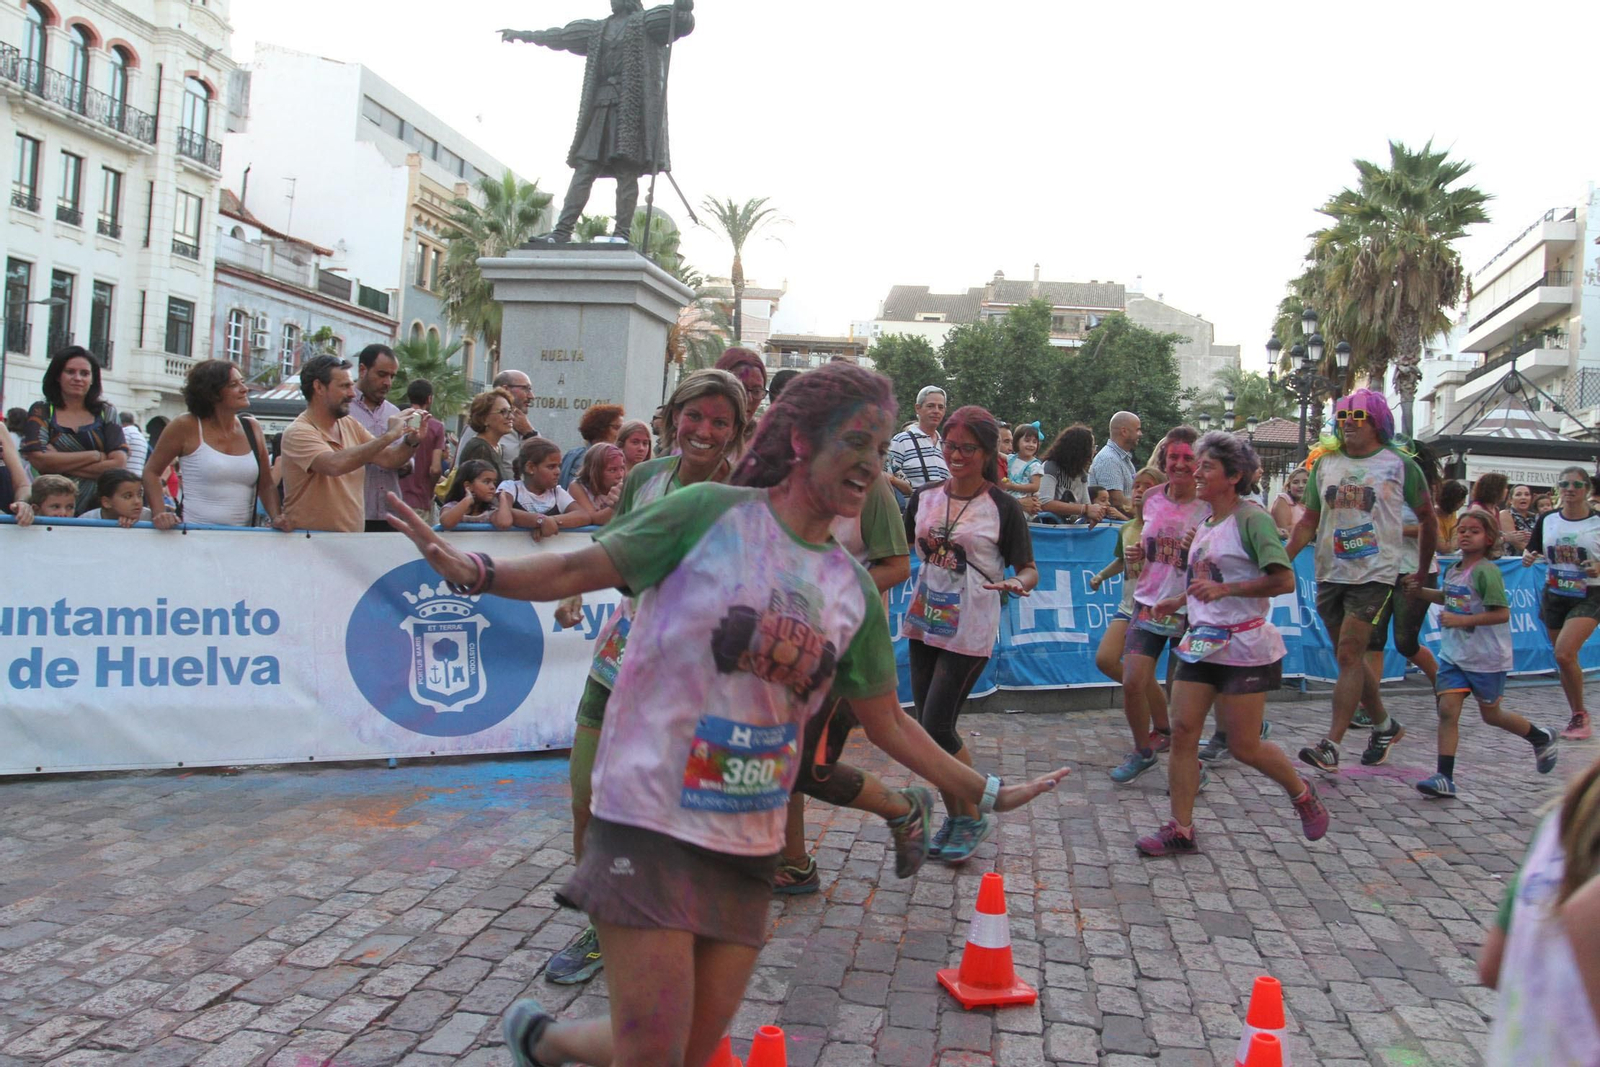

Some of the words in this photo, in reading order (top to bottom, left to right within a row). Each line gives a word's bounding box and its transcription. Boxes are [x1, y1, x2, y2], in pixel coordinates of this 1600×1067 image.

[541, 349, 585, 361] HUELVA
[557, 372, 565, 385] A
[1342, 537, 1363, 550] 560
[8, 646, 80, 690] de
[95, 646, 281, 688] Huelva
[724, 758, 776, 785] 360
